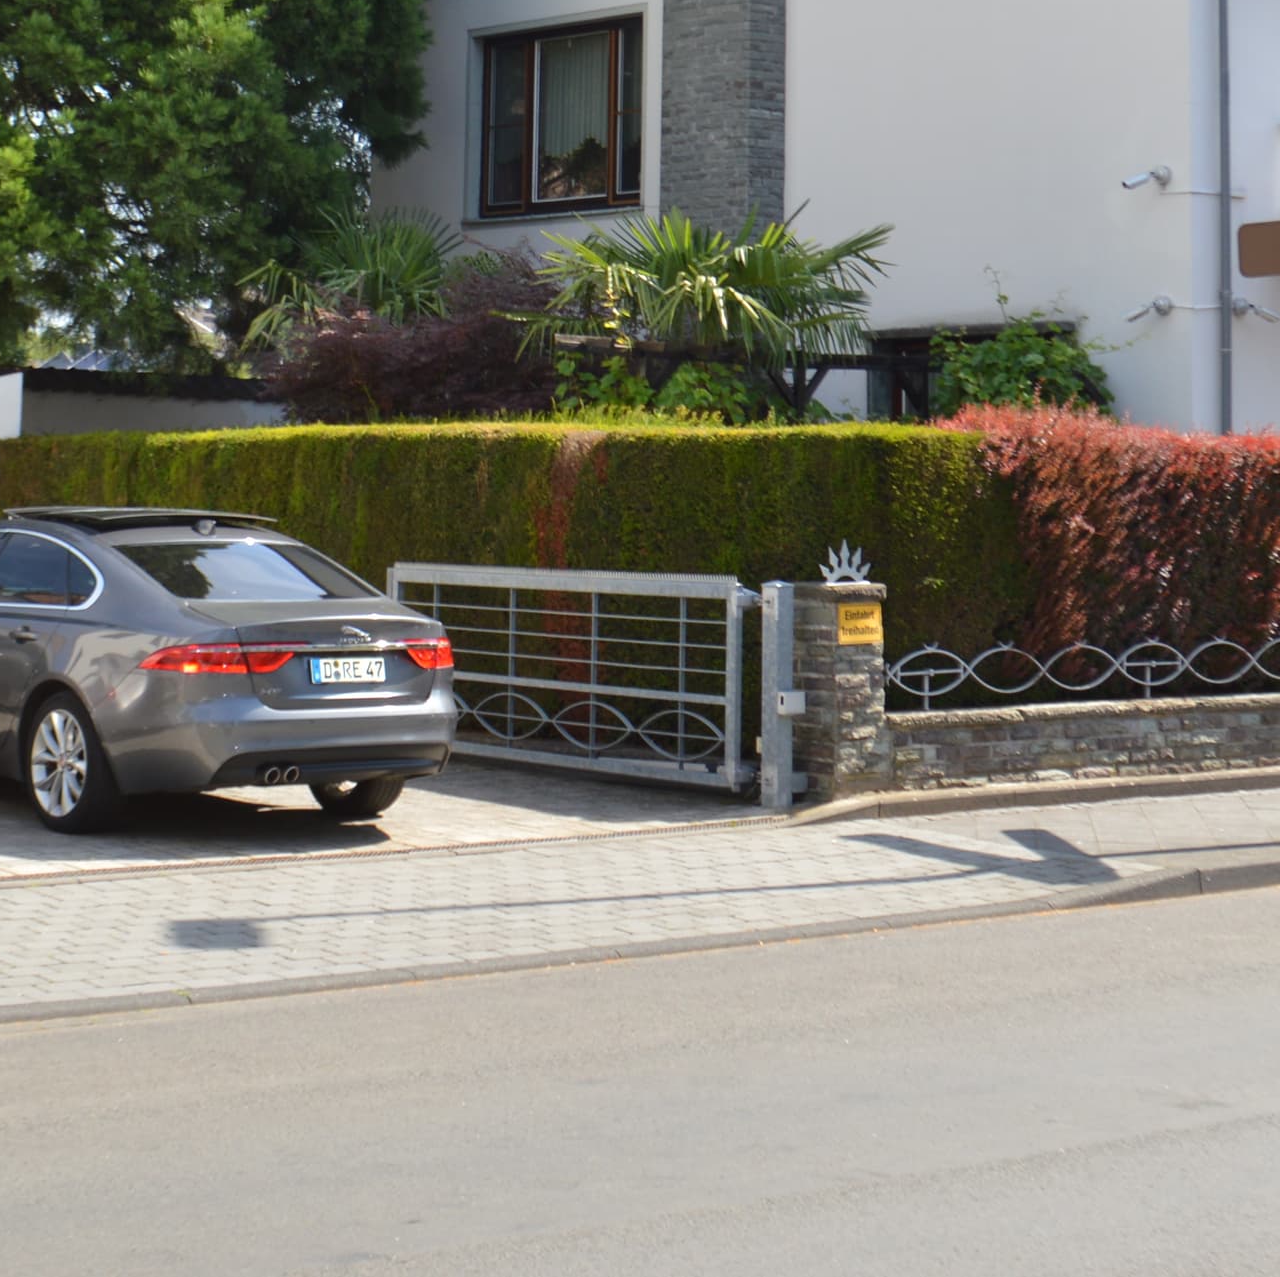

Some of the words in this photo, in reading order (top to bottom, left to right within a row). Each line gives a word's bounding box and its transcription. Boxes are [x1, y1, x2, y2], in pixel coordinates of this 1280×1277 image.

[323, 661, 333, 679] D
[342, 661, 363, 679] RE
[366, 660, 384, 678] 47
